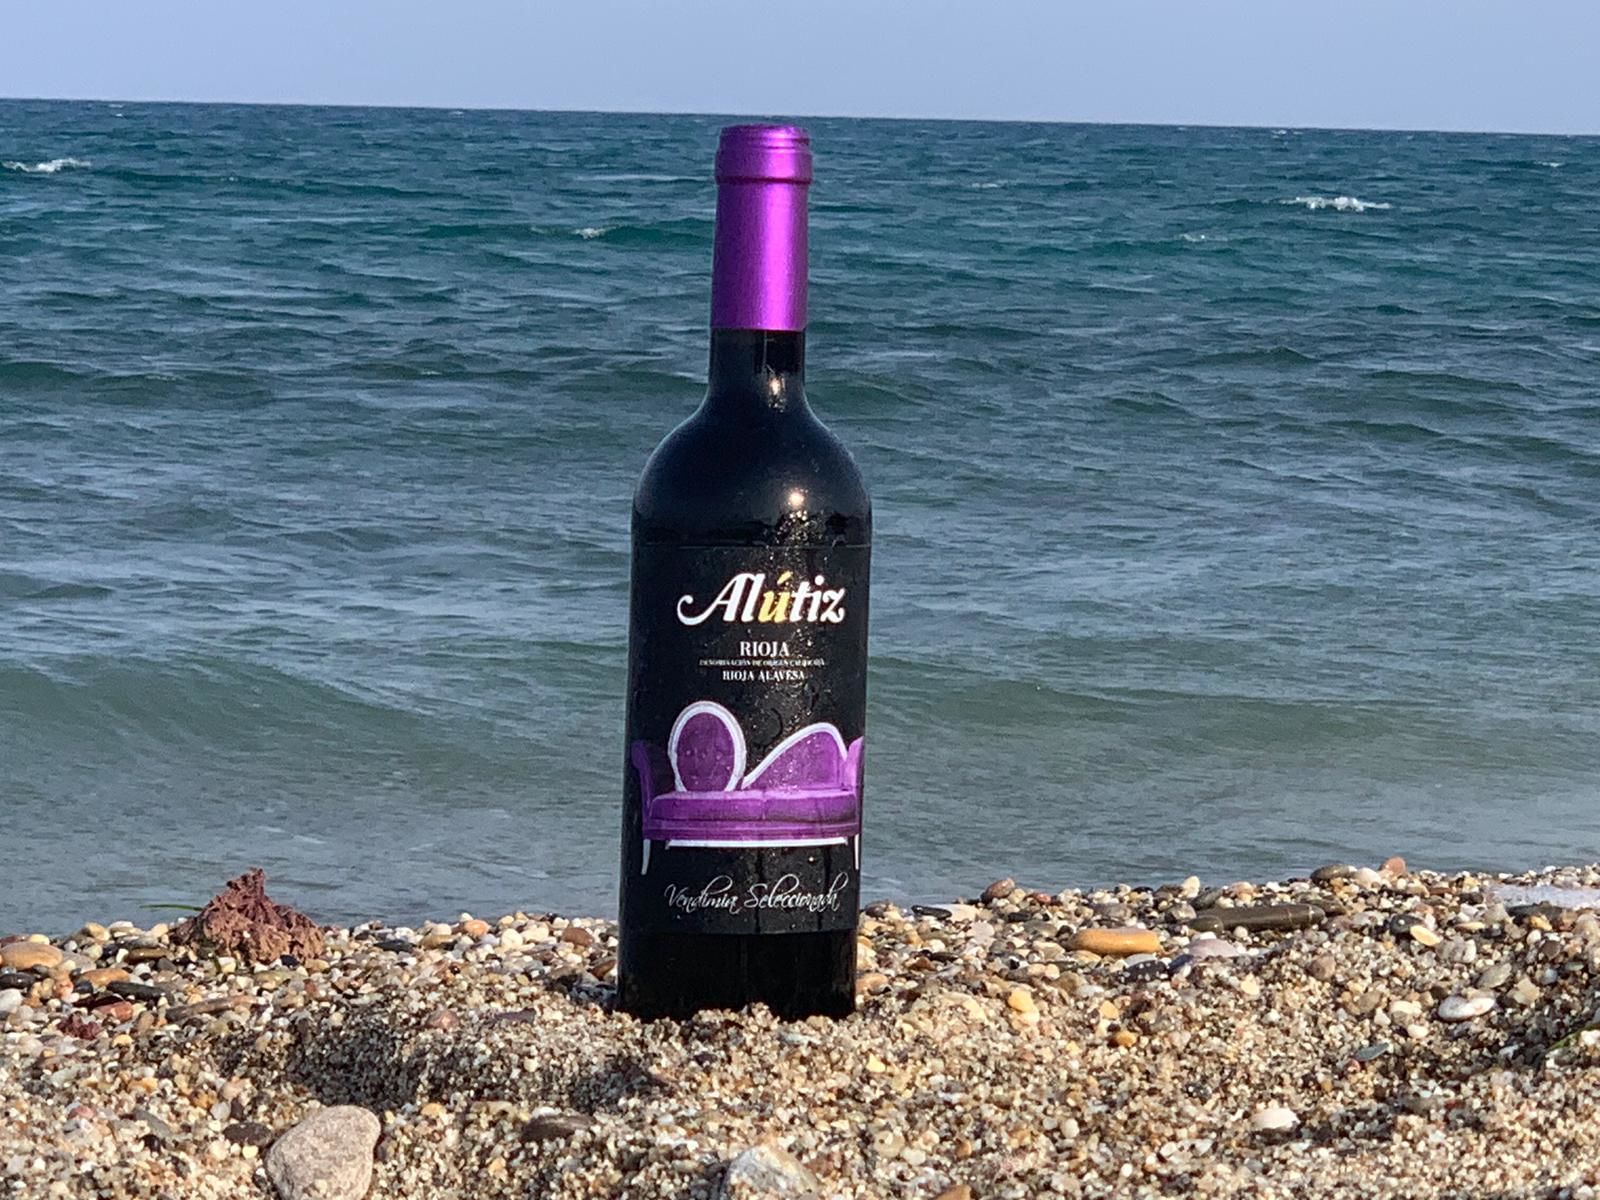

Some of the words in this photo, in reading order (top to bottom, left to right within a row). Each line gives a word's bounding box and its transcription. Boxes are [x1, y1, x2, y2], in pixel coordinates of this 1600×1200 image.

[676, 570, 846, 626] Alútiz
[739, 640, 790, 657] RIOJA
[722, 670, 755, 681] RIOJA
[758, 670, 806, 683] ALAVESA
[664, 874, 741, 915] Vendimia
[744, 871, 849, 914] Seleccionada
